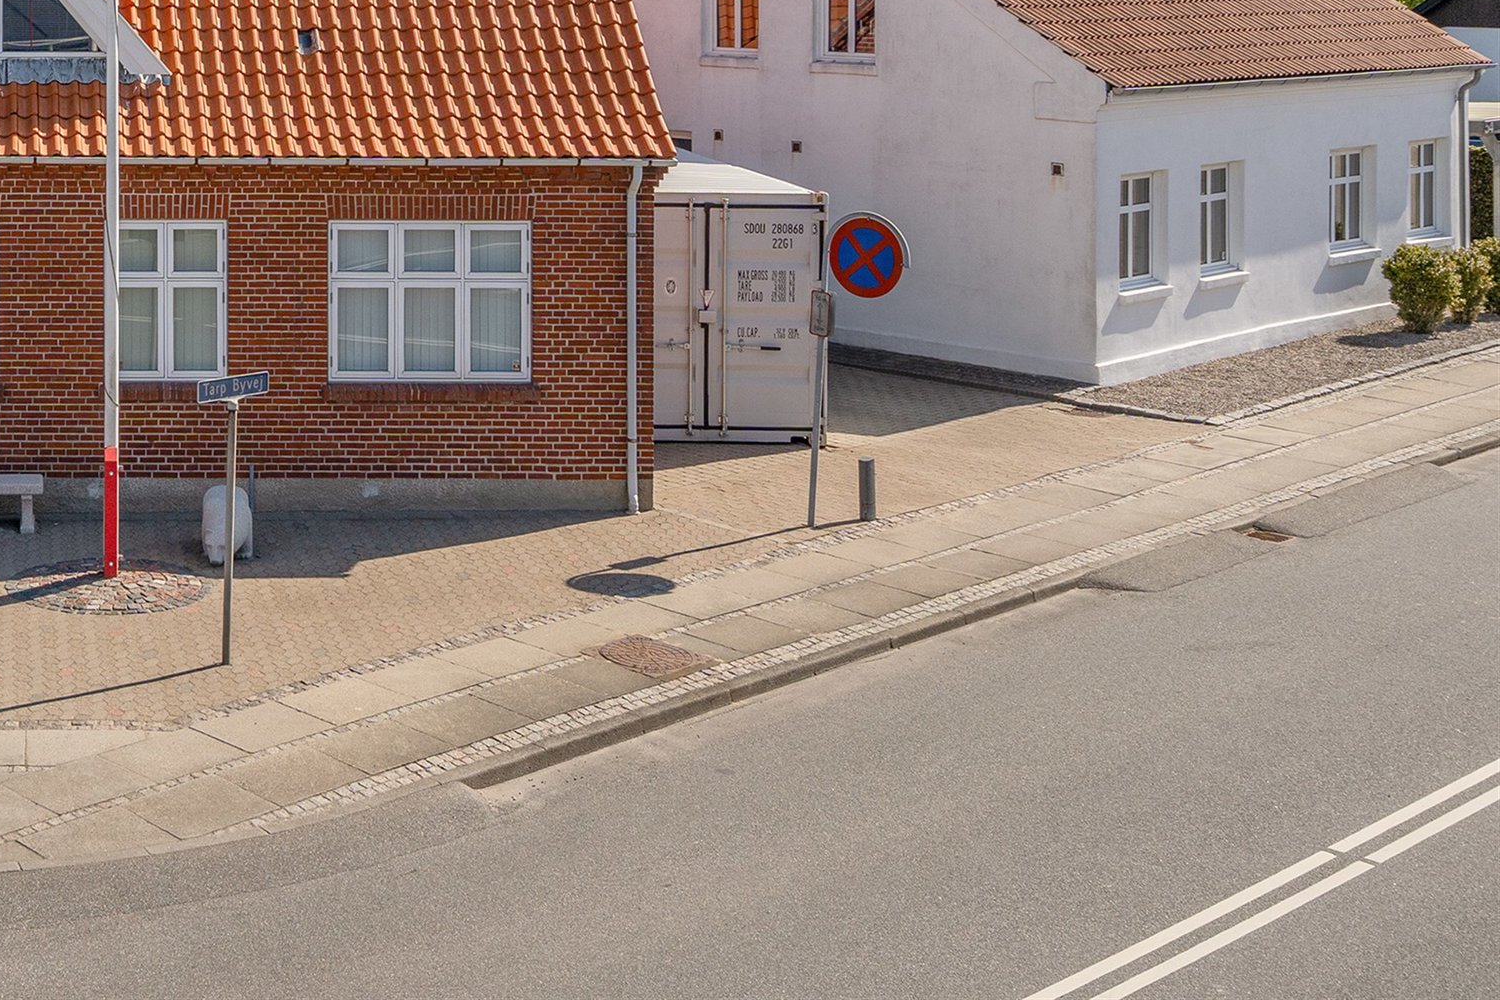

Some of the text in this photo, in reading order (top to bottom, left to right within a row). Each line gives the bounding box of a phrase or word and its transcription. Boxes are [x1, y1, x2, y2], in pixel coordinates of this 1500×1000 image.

[743, 222, 819, 235] SDOU 280868 3
[772, 238, 793, 249] 22G1
[737, 281, 752, 292] TARE
[737, 291, 763, 302] PAYLOAD
[203, 375, 264, 397] Tarp Byvej
